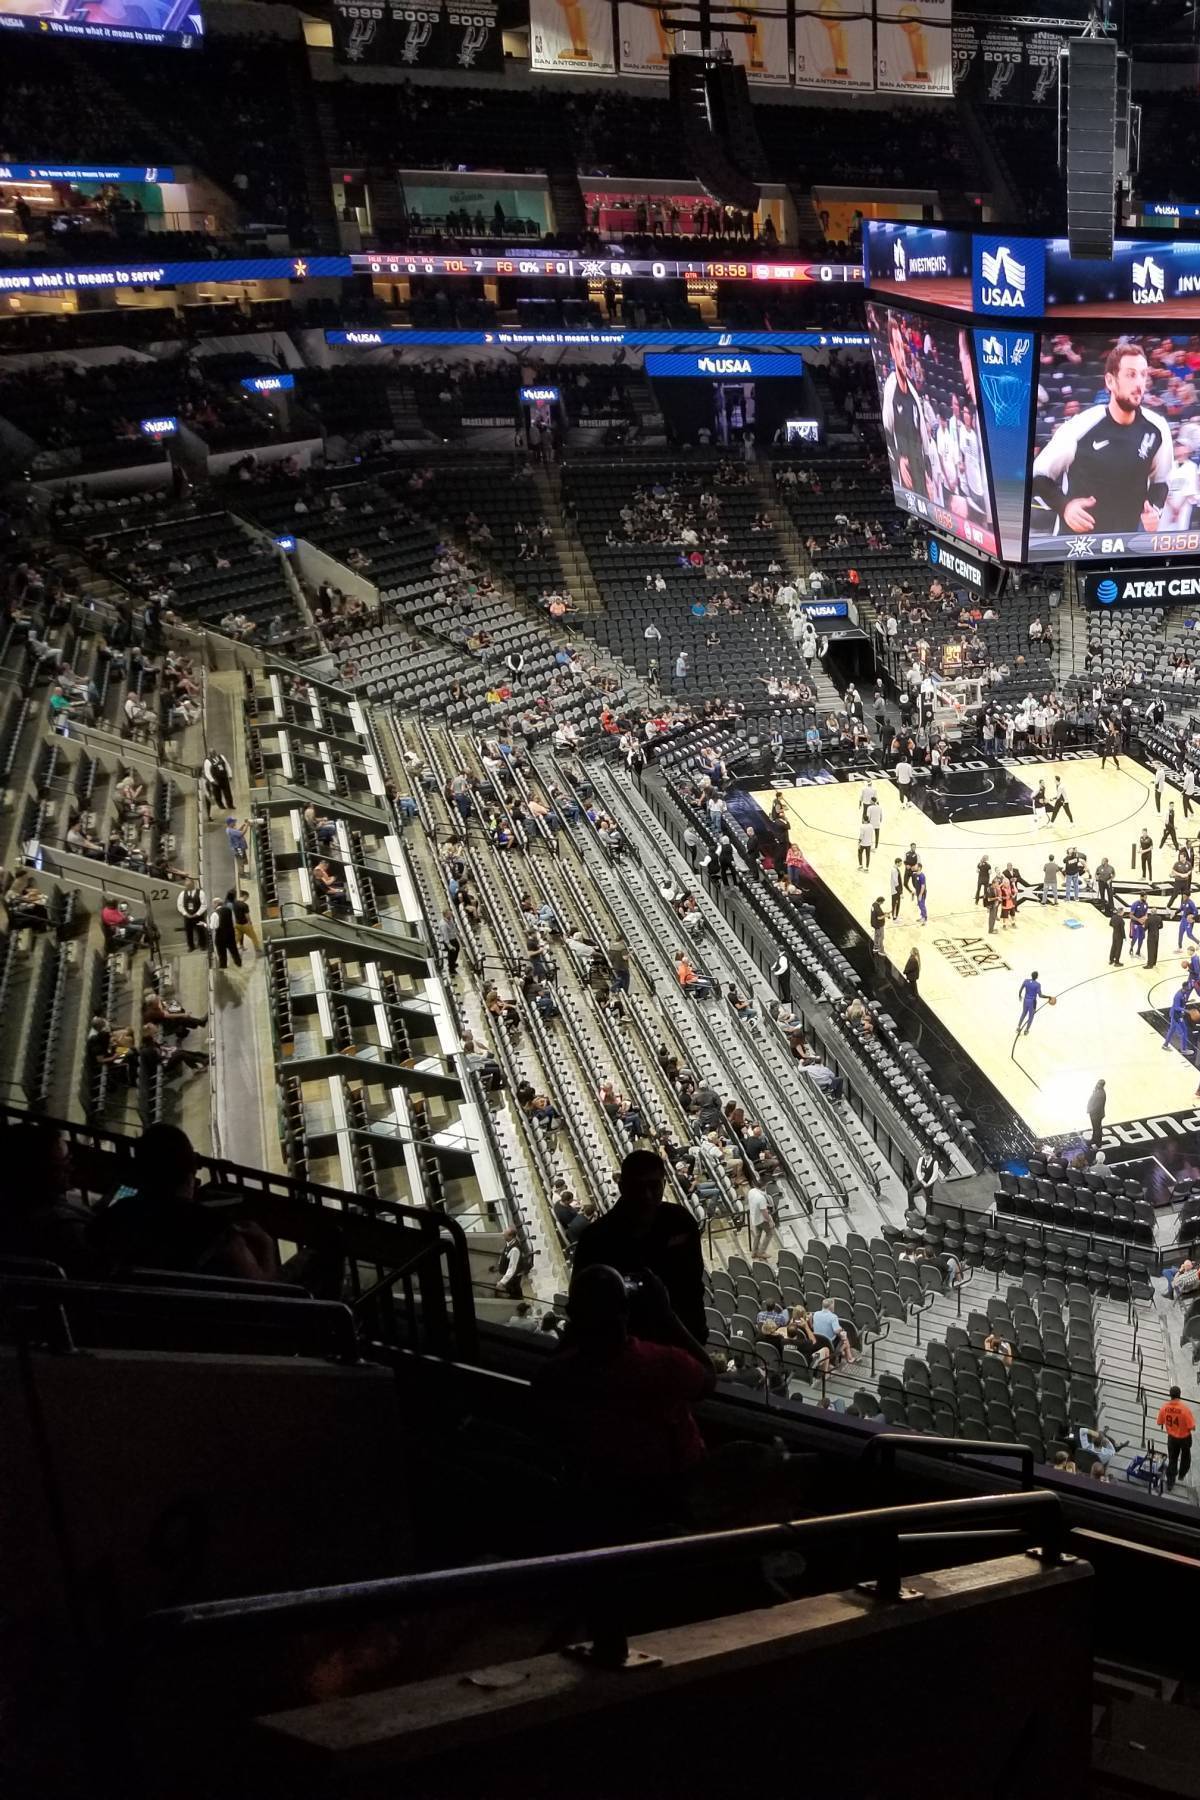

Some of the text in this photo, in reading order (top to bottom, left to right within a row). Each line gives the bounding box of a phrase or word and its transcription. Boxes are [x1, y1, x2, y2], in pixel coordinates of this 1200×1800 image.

[338, 7, 383, 19] 1999
[392, 10, 440, 23] 2003
[450, 16, 495, 28] 2005
[51, 23, 143, 40] We know what it means to
[984, 52, 1021, 62] 2013
[372, 263, 433, 273] 0 0 0 0
[444, 260, 467, 272] TOL
[475, 261, 482, 272] 7
[497, 261, 513, 272] FG
[519, 262, 539, 273] 0%
[546, 263, 553, 272] F
[556, 263, 565, 273] 0
[611, 262, 632, 275] SA
[652, 263, 665, 278] 0
[707, 264, 747, 277] 13:58
[821, 267, 832, 281] 0
[909, 256, 946, 272] INVESTMENTS
[32, 273, 63, 287] what
[65, 271, 76, 285] it
[78, 272, 114, 284] means
[117, 271, 129, 282] to
[894, 268, 906, 281] USAA
[982, 287, 1025, 307] USAA
[1132, 289, 1164, 304] USAA
[358, 334, 381, 342] USAA
[499, 334, 512, 342] We
[513, 334, 534, 342] know
[536, 334, 555, 342] what
[557, 334, 564, 342] it
[591, 334, 599, 342] to
[832, 336, 842, 344] We
[843, 336, 862, 344] know
[983, 354, 1003, 364] USAA
[715, 360, 752, 373] USAA
[264, 379, 280, 389] USAA
[534, 390, 555, 399] USAA
[154, 420, 174, 431] USAA
[1102, 539, 1124, 552] SA
[1151, 534, 1199, 551] 13:58
[939, 549, 981, 586] AT&T CENTER
[1123, 580, 1166, 598] AT&T
[817, 606, 836, 615] USAA
[771, 775, 839, 789] SAN
[151, 889, 170, 900] 22
[933, 939, 979, 977] CENTER
[952, 937, 1012, 971] AT&T
